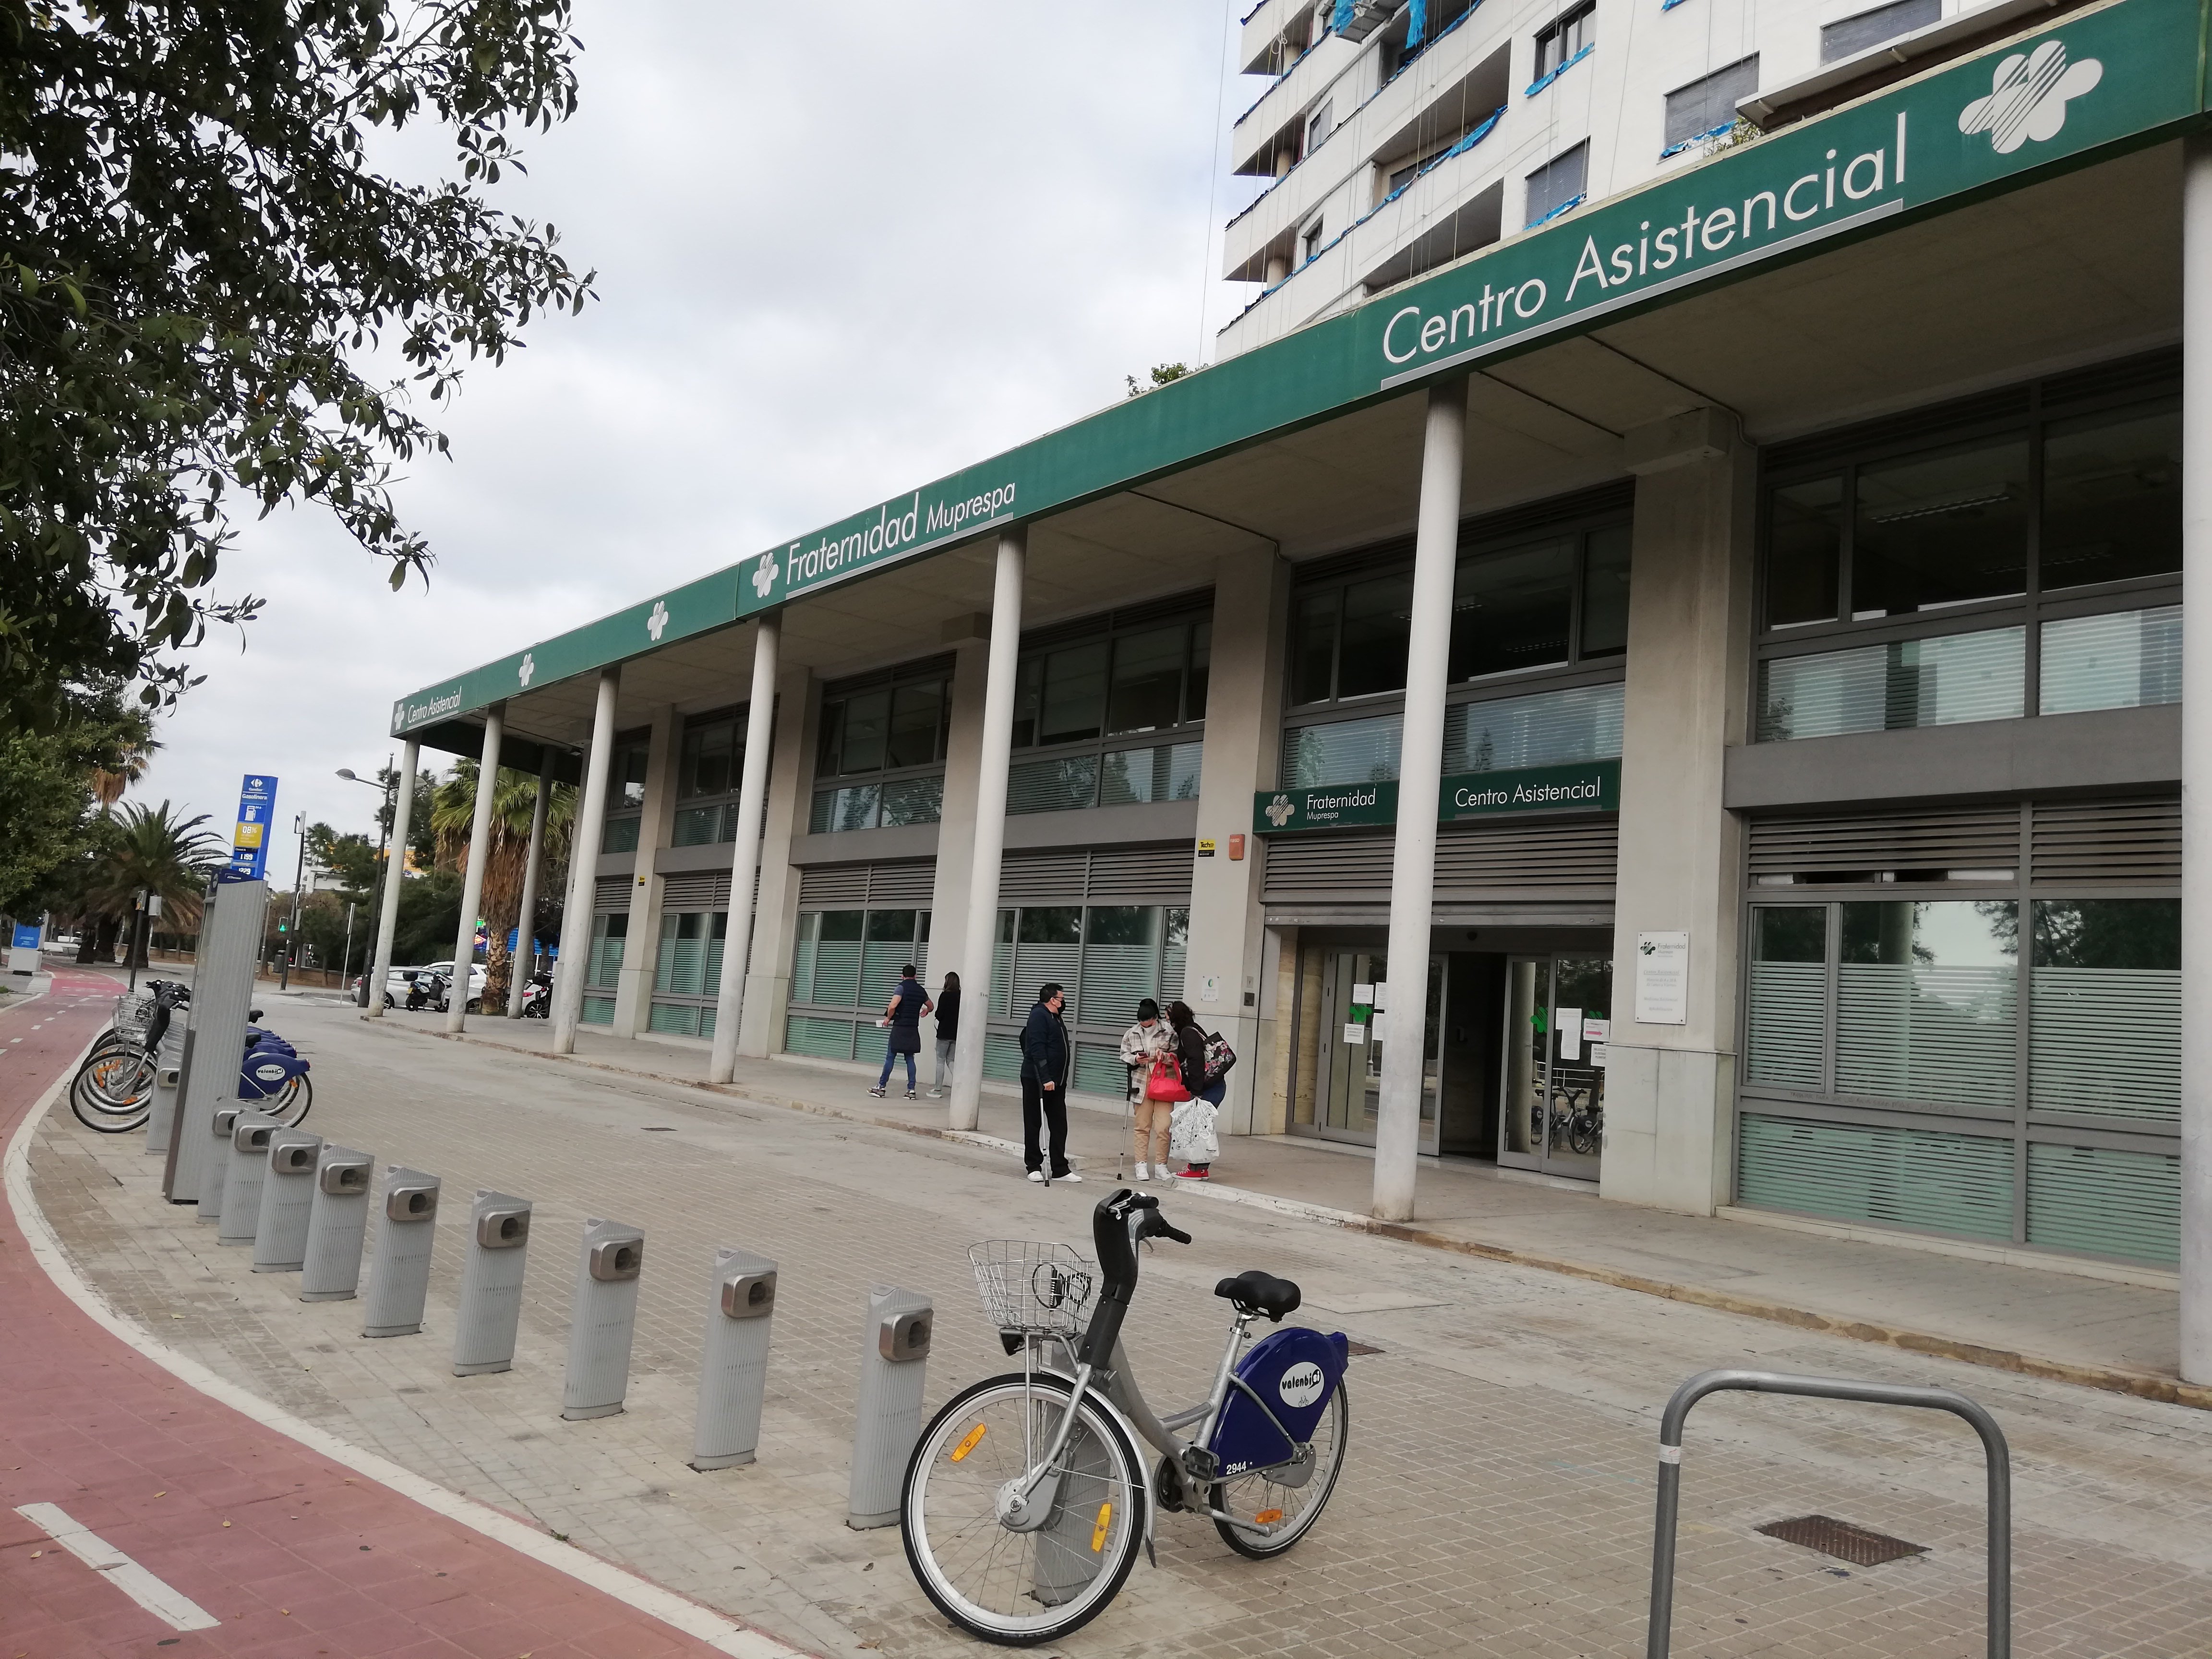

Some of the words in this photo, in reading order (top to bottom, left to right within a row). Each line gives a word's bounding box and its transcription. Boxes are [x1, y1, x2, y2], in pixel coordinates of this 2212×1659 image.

[1382, 277, 1546, 364] Centro
[1564, 111, 1908, 302] Asistencial
[786, 491, 920, 585] Fraternidad
[926, 481, 1016, 534] Muprespa
[408, 704, 427, 723] Centro
[427, 685, 462, 717] Asistencial
[1307, 787, 1376, 810] Fraternidad
[1455, 785, 1508, 808] Centro
[1513, 776, 1601, 804] Asistencial
[1306, 811, 1339, 821] Muprespa
[1226, 1461, 1247, 1475] 2944
